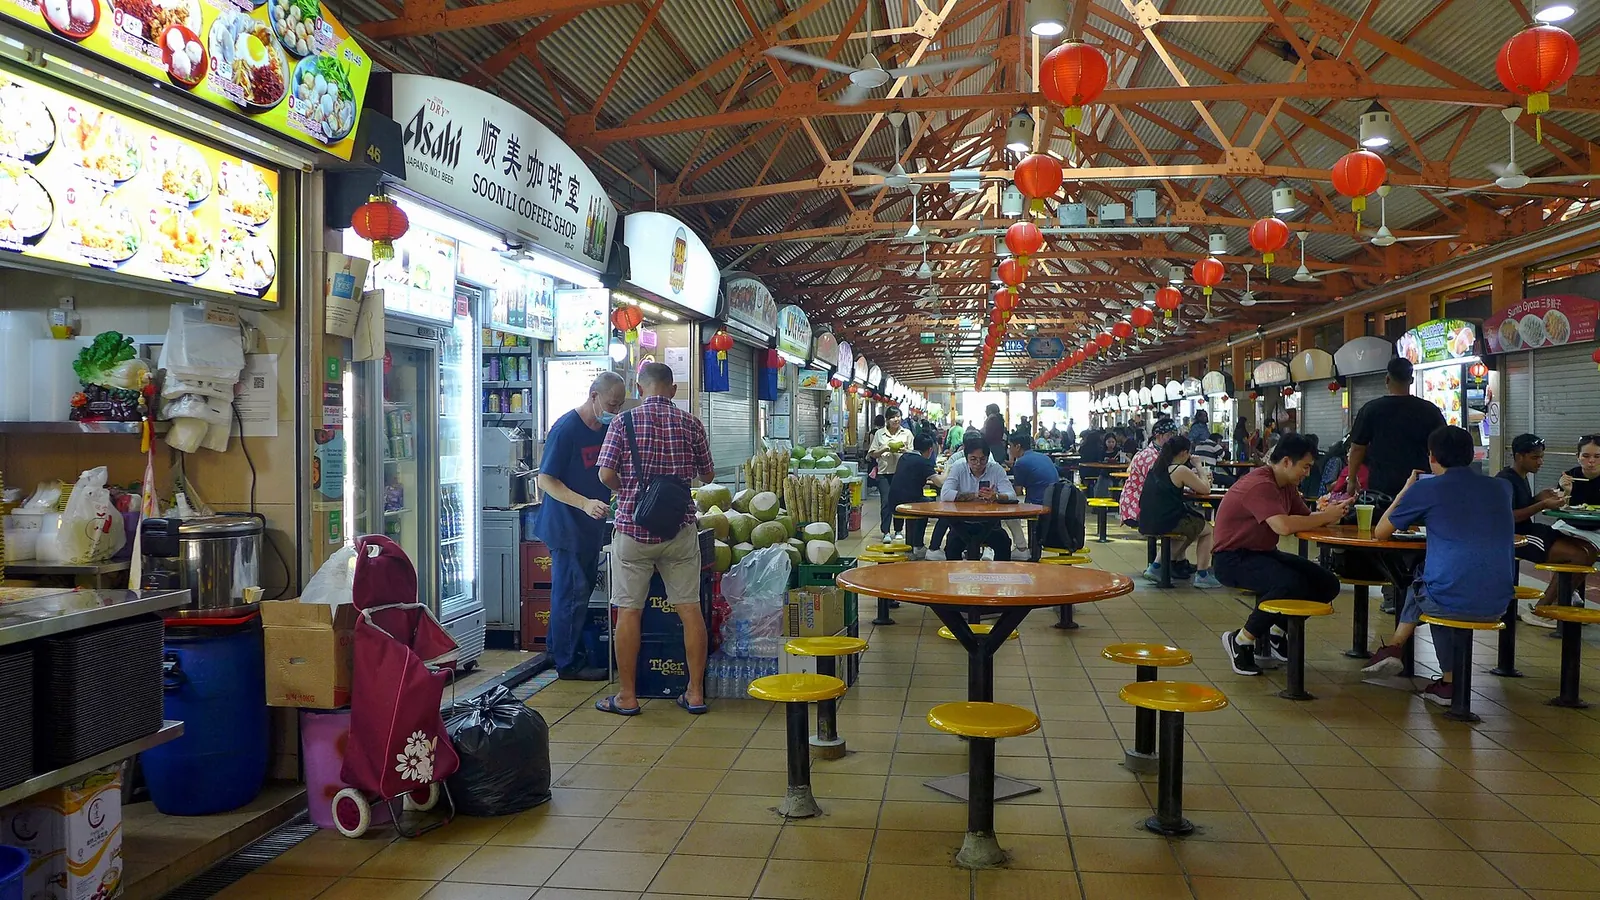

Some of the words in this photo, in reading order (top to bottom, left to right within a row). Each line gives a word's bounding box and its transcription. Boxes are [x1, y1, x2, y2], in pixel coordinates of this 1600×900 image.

[404, 104, 463, 170] Asahi
[366, 144, 381, 164] 46
[476, 117, 580, 214] 顺美咖啡室
[441, 173, 454, 185] BEER
[472, 173, 506, 206] SOON
[507, 190, 518, 213] LI
[518, 197, 553, 229] COFFEE
[554, 215, 577, 240] SHOP
[1522, 300, 1540, 313] Gyoza
[806, 601, 814, 629] KINGS
[648, 658, 685, 676] Tiger
